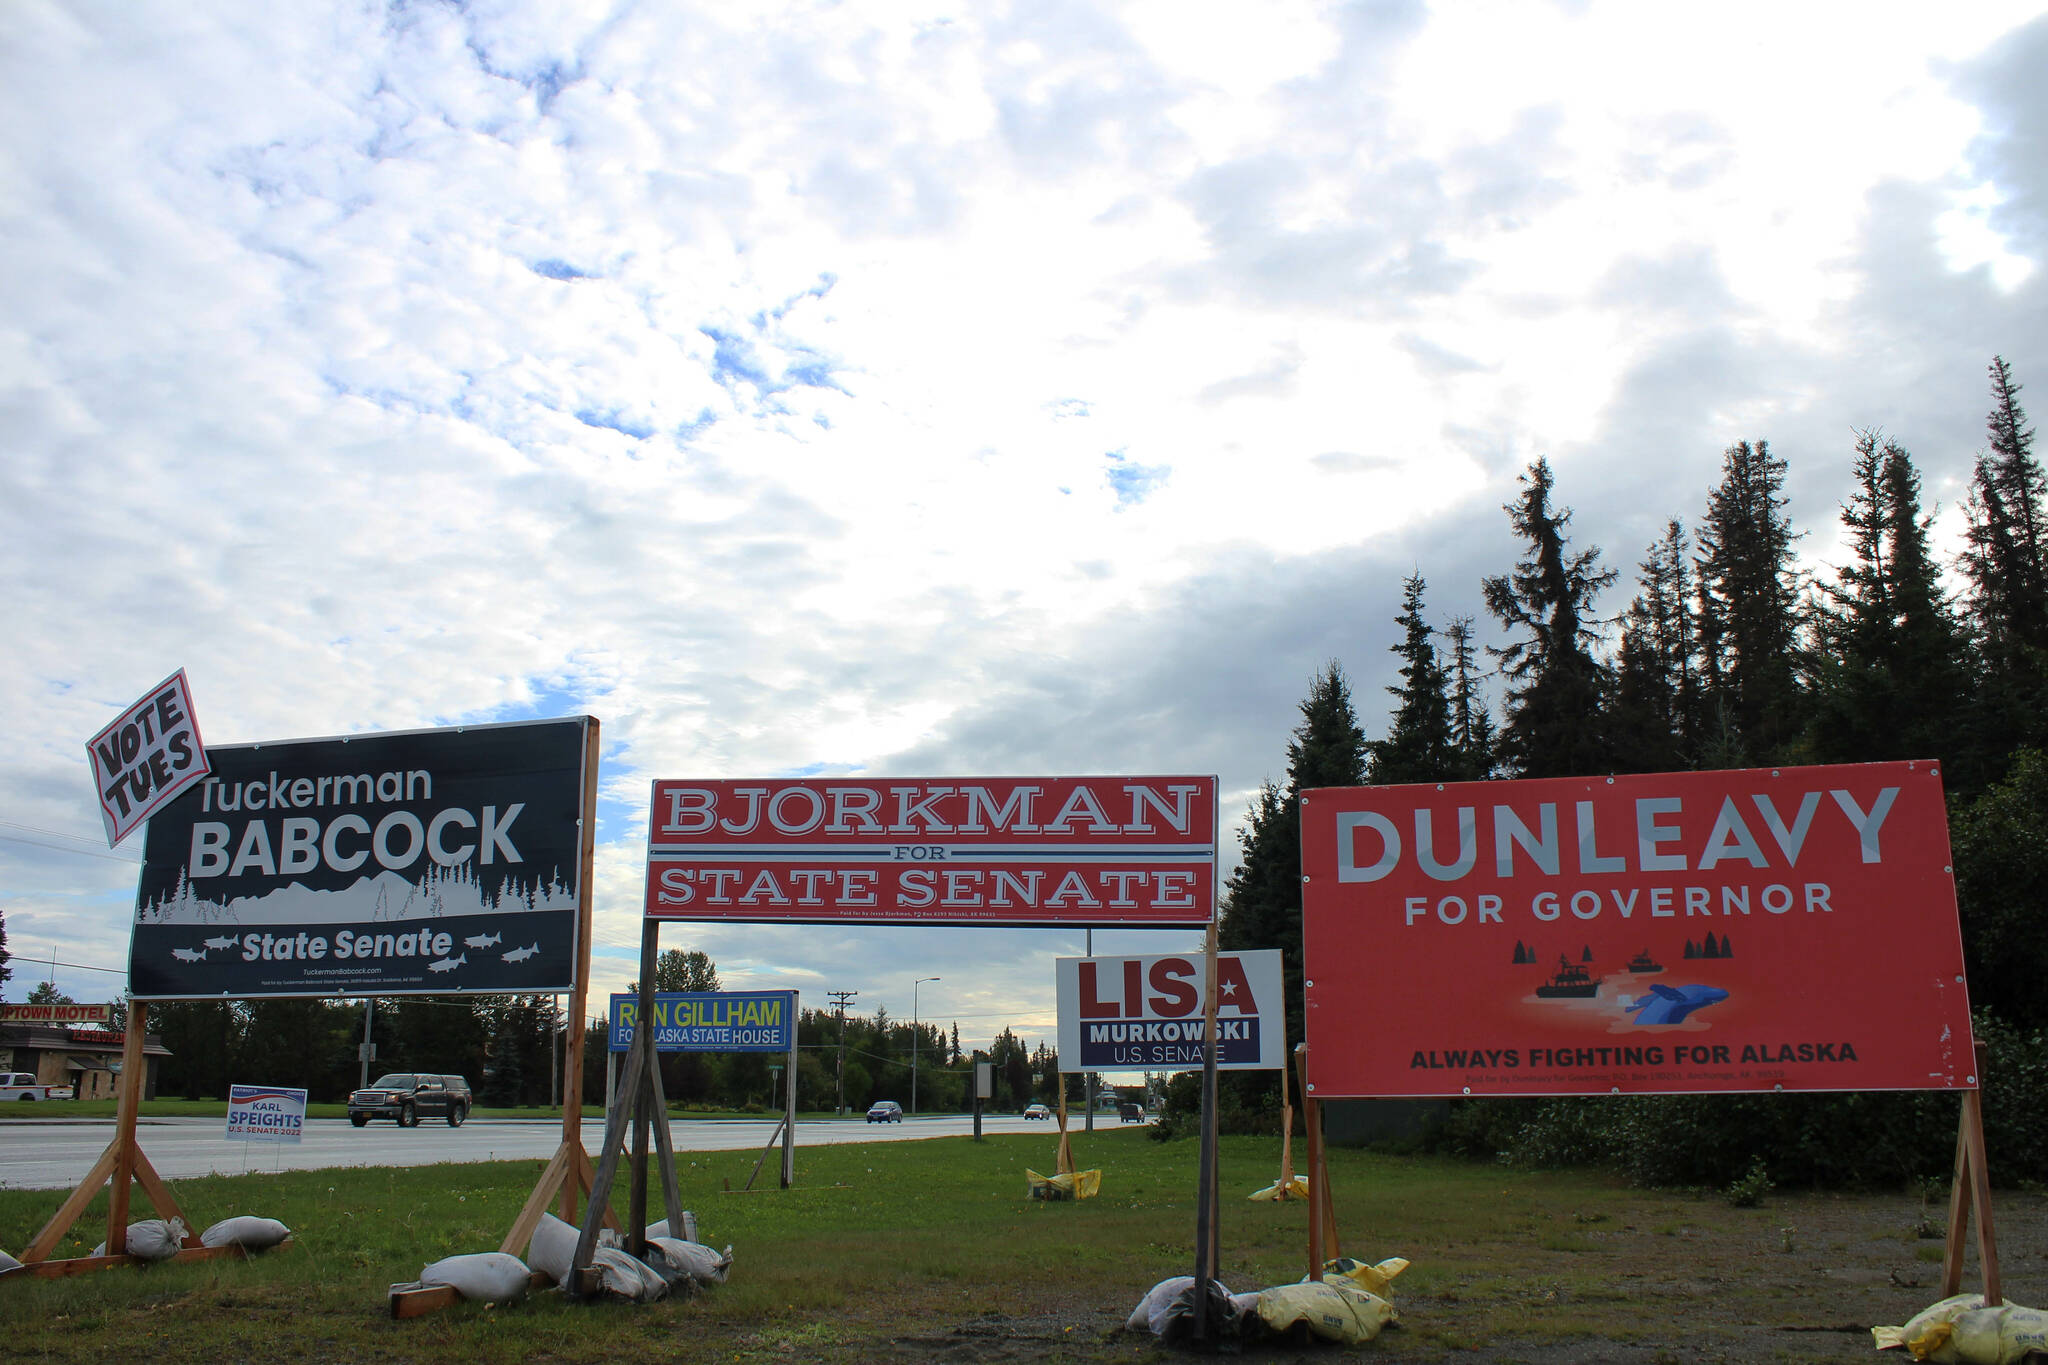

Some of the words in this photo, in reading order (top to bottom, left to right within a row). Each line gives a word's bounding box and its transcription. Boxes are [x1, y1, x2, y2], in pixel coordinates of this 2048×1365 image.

[98, 688, 184, 777] VOTE
[105, 731, 192, 818] TUES
[200, 769, 432, 812] Tuckerman
[661, 785, 1200, 835] BJORKMAN
[189, 803, 525, 878] BABCOCK
[1336, 787, 1900, 883] DUNLEAVY
[894, 846, 946, 860] FOR
[658, 868, 879, 908] STATE
[896, 869, 1198, 909] SENATE
[1405, 895, 1504, 925] FOR
[1532, 883, 1833, 921] GOVERNOR
[242, 932, 328, 962] State
[334, 929, 453, 959] Senate
[303, 968, 382, 976] TuckermanBabcock.com
[1078, 957, 1259, 1018] LISA
[54, 1006, 108, 1019] MOTEL
[619, 1002, 667, 1027] RN
[674, 1001, 780, 1027] GILLHAM
[691, 1028, 729, 1043] STATE
[732, 1029, 780, 1044] HOUSE
[1114, 1046, 1146, 1063] U.S.
[1152, 1045, 1225, 1062] SENAE
[1410, 1049, 1519, 1069] ALWAYS
[1529, 1046, 1664, 1067] FIGHTING
[1674, 1045, 1731, 1065] FOR
[1740, 1042, 1858, 1064] ALASKA
[229, 1111, 302, 1128] SPEIGHTS
[252, 1102, 282, 1111] KARL
[228, 1125, 243, 1133] U.S.
[246, 1126, 279, 1135] SENATE
